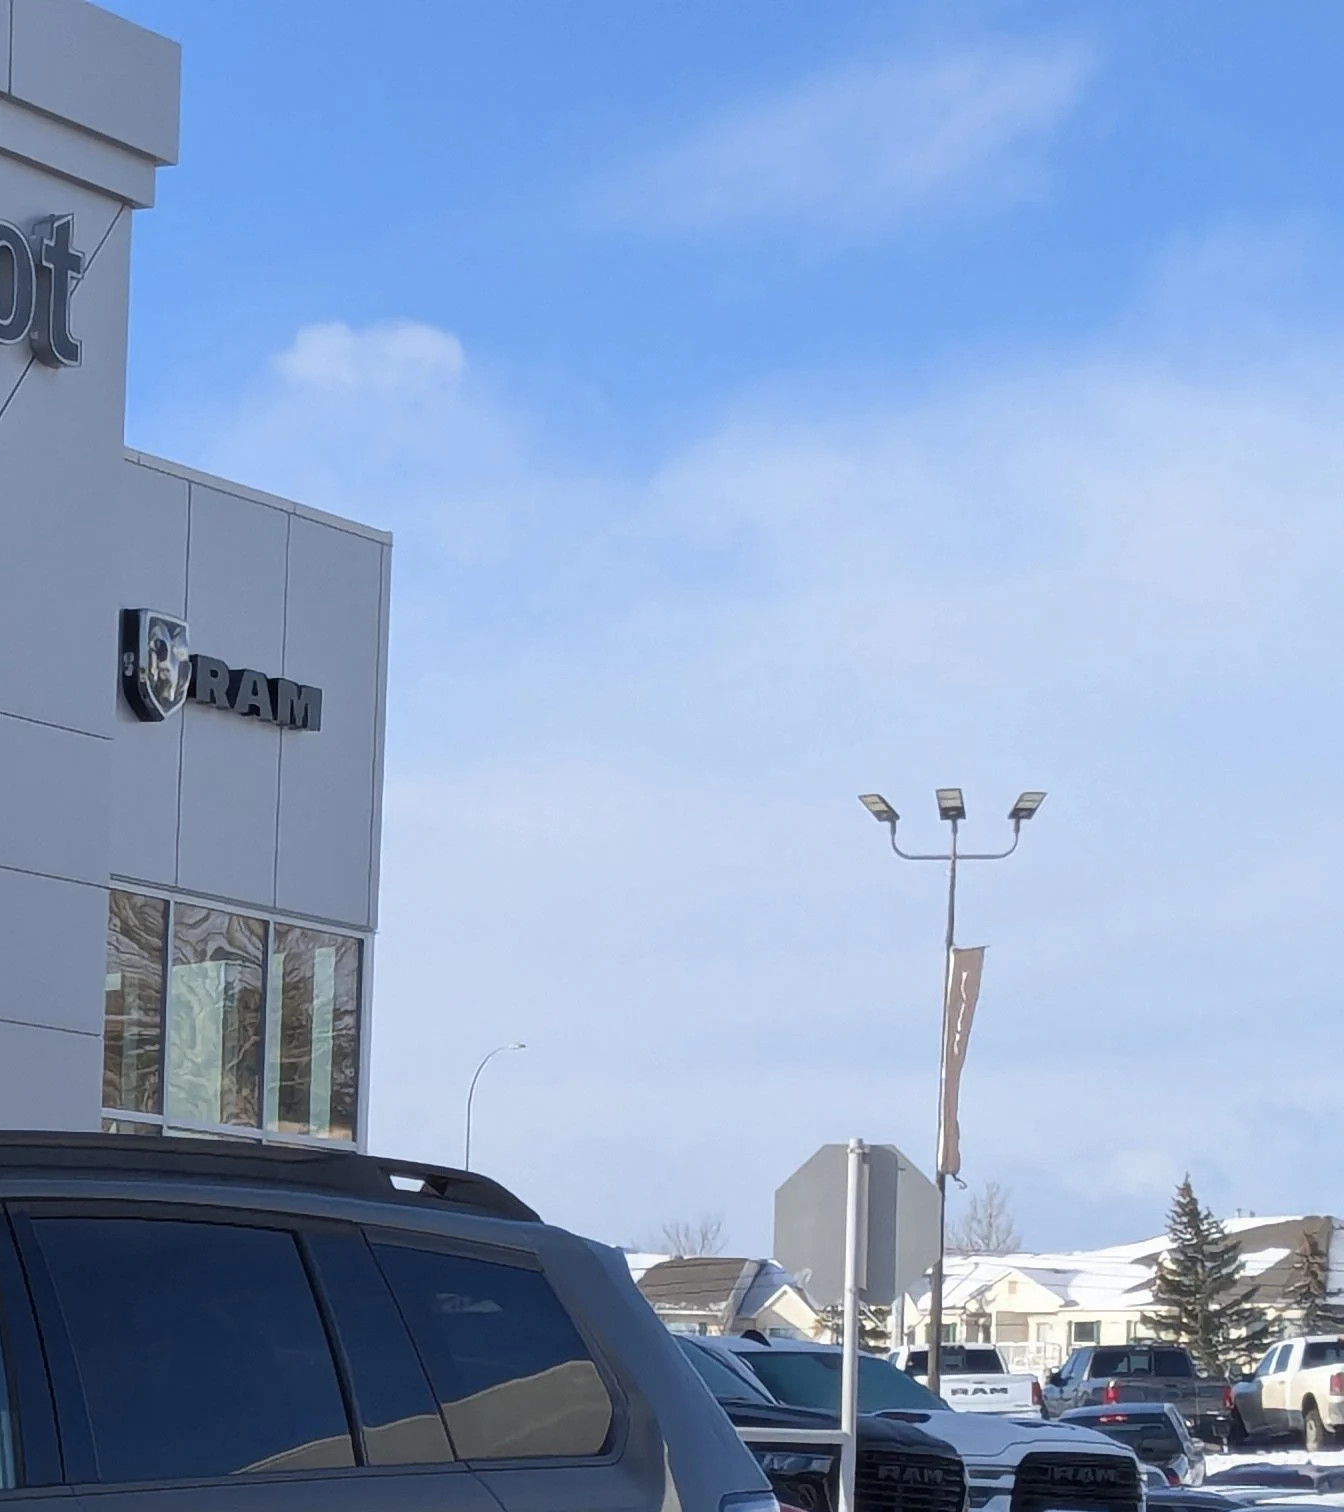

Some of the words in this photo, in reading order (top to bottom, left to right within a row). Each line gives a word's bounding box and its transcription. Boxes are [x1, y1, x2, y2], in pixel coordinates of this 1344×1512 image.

[188, 653, 323, 732] RAM
[951, 1387, 1009, 1396] RAM
[877, 1465, 944, 1485] RAM
[1053, 1466, 1116, 1483] RAM
